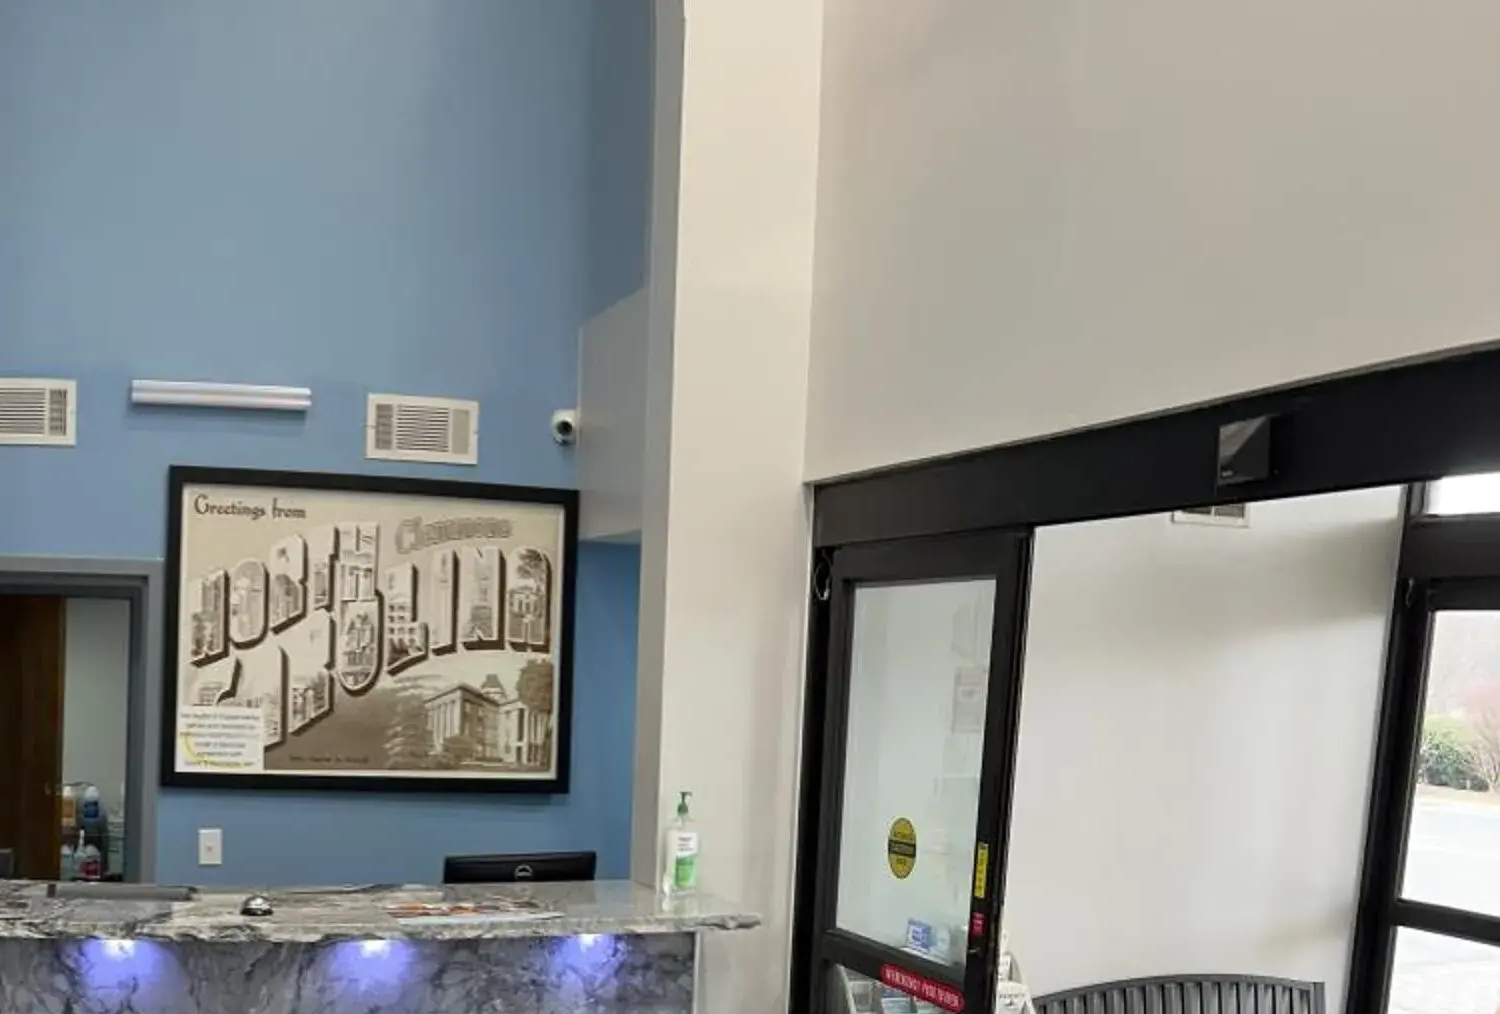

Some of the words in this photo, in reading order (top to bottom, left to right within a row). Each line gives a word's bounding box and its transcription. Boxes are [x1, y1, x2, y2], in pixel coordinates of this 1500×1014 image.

[194, 494, 266, 521] Greetings
[272, 497, 306, 519] from
[188, 521, 384, 669] NORTH
